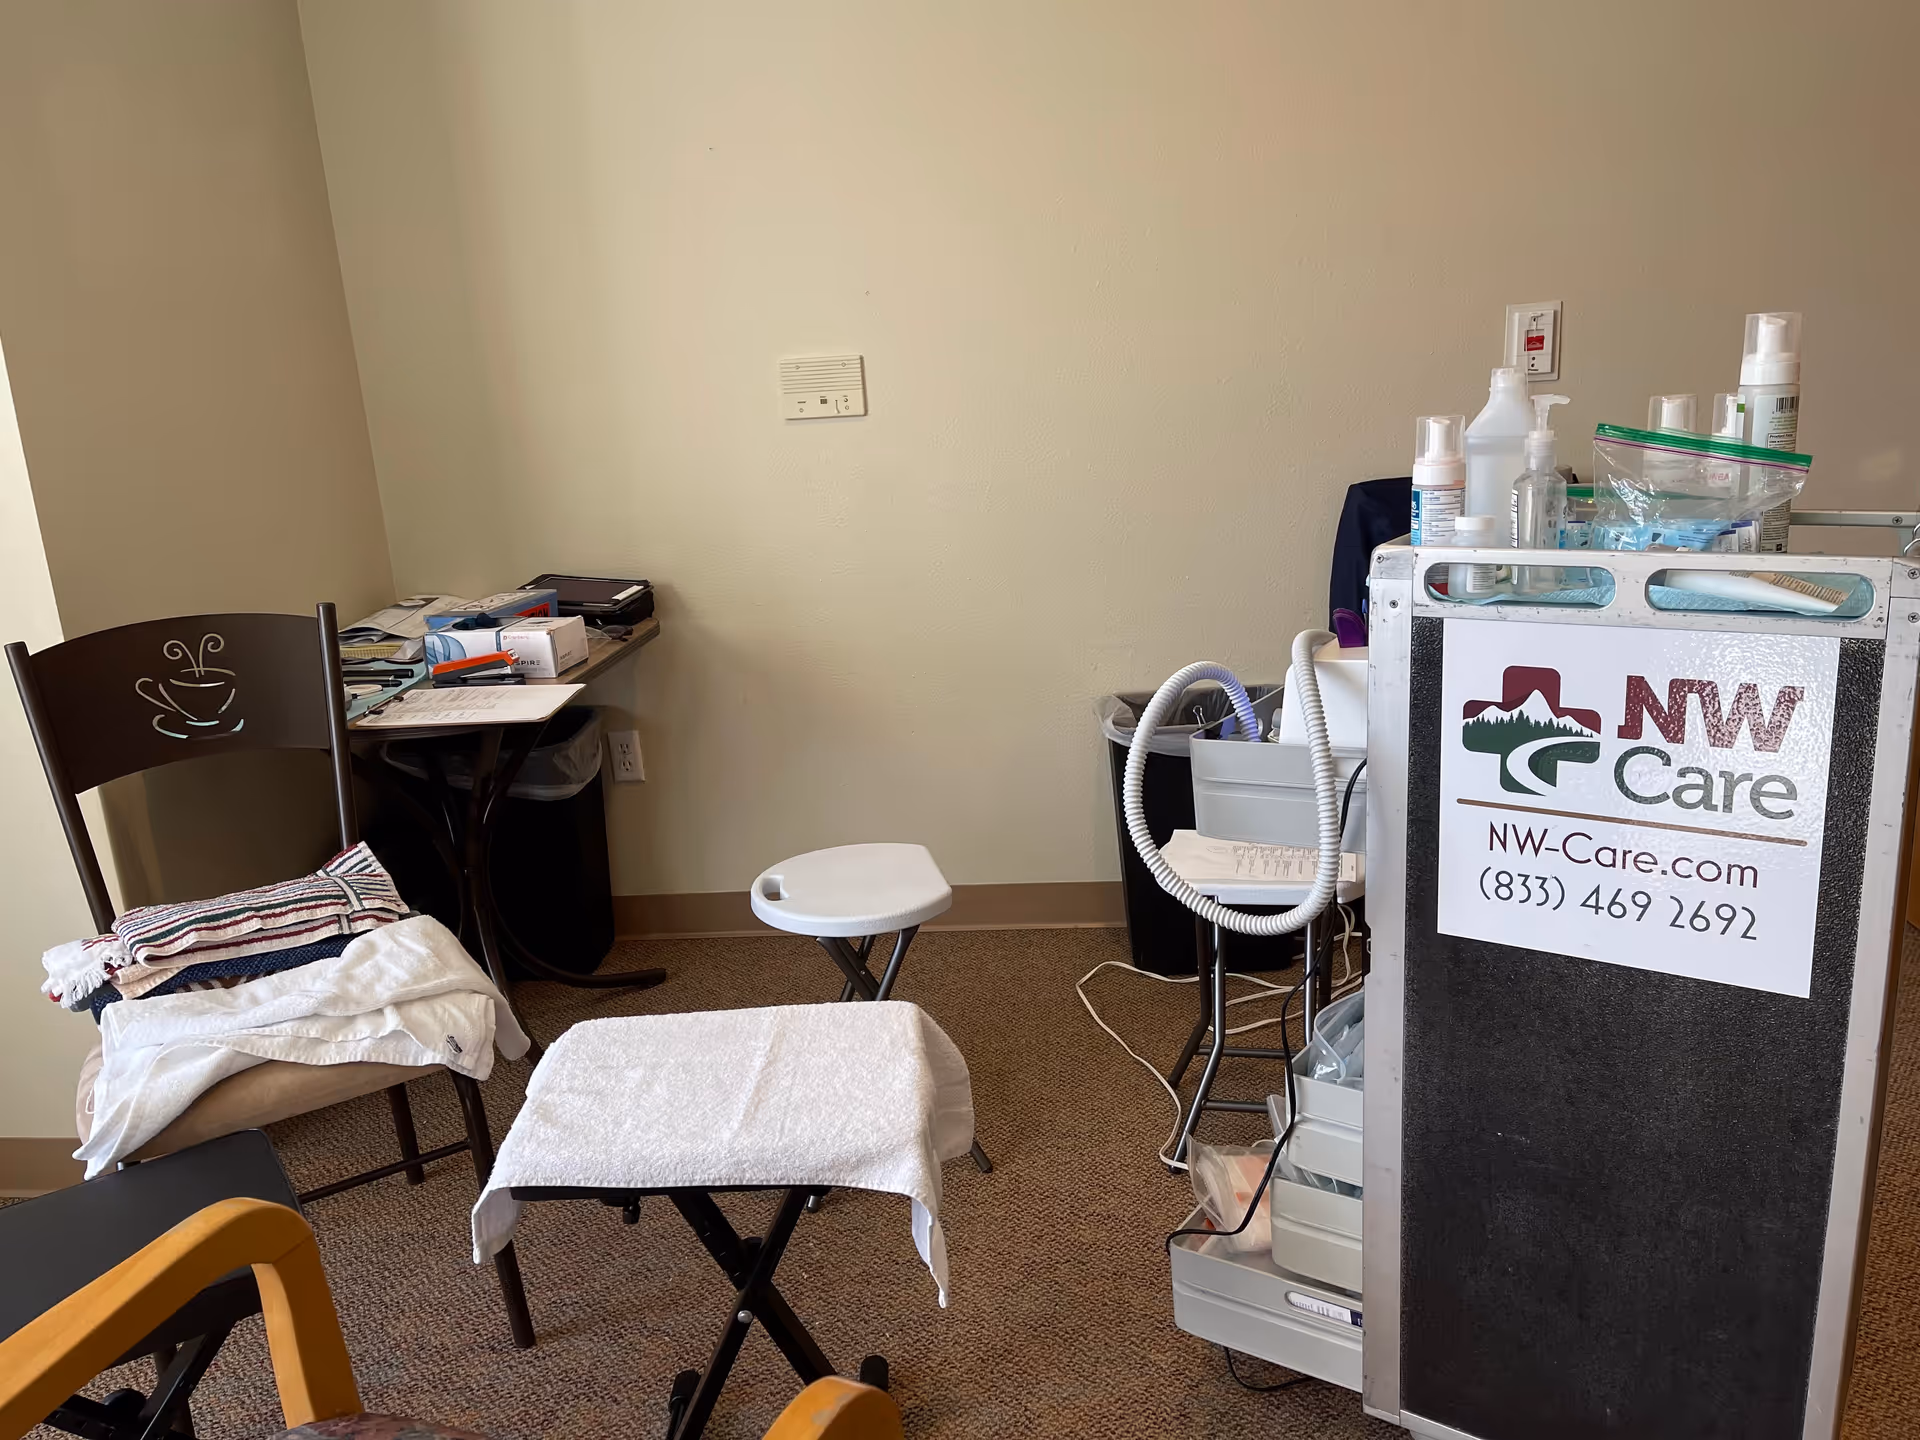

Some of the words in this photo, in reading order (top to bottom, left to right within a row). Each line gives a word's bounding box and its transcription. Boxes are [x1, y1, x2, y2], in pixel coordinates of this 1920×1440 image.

[1617, 675, 1805, 753] NW
[1614, 746, 1798, 820] Care
[1488, 821, 1759, 888] NW-Care.com
[1479, 867, 1566, 911] (833)
[1580, 884, 1652, 922] 469
[1670, 895, 1757, 941] 2692
